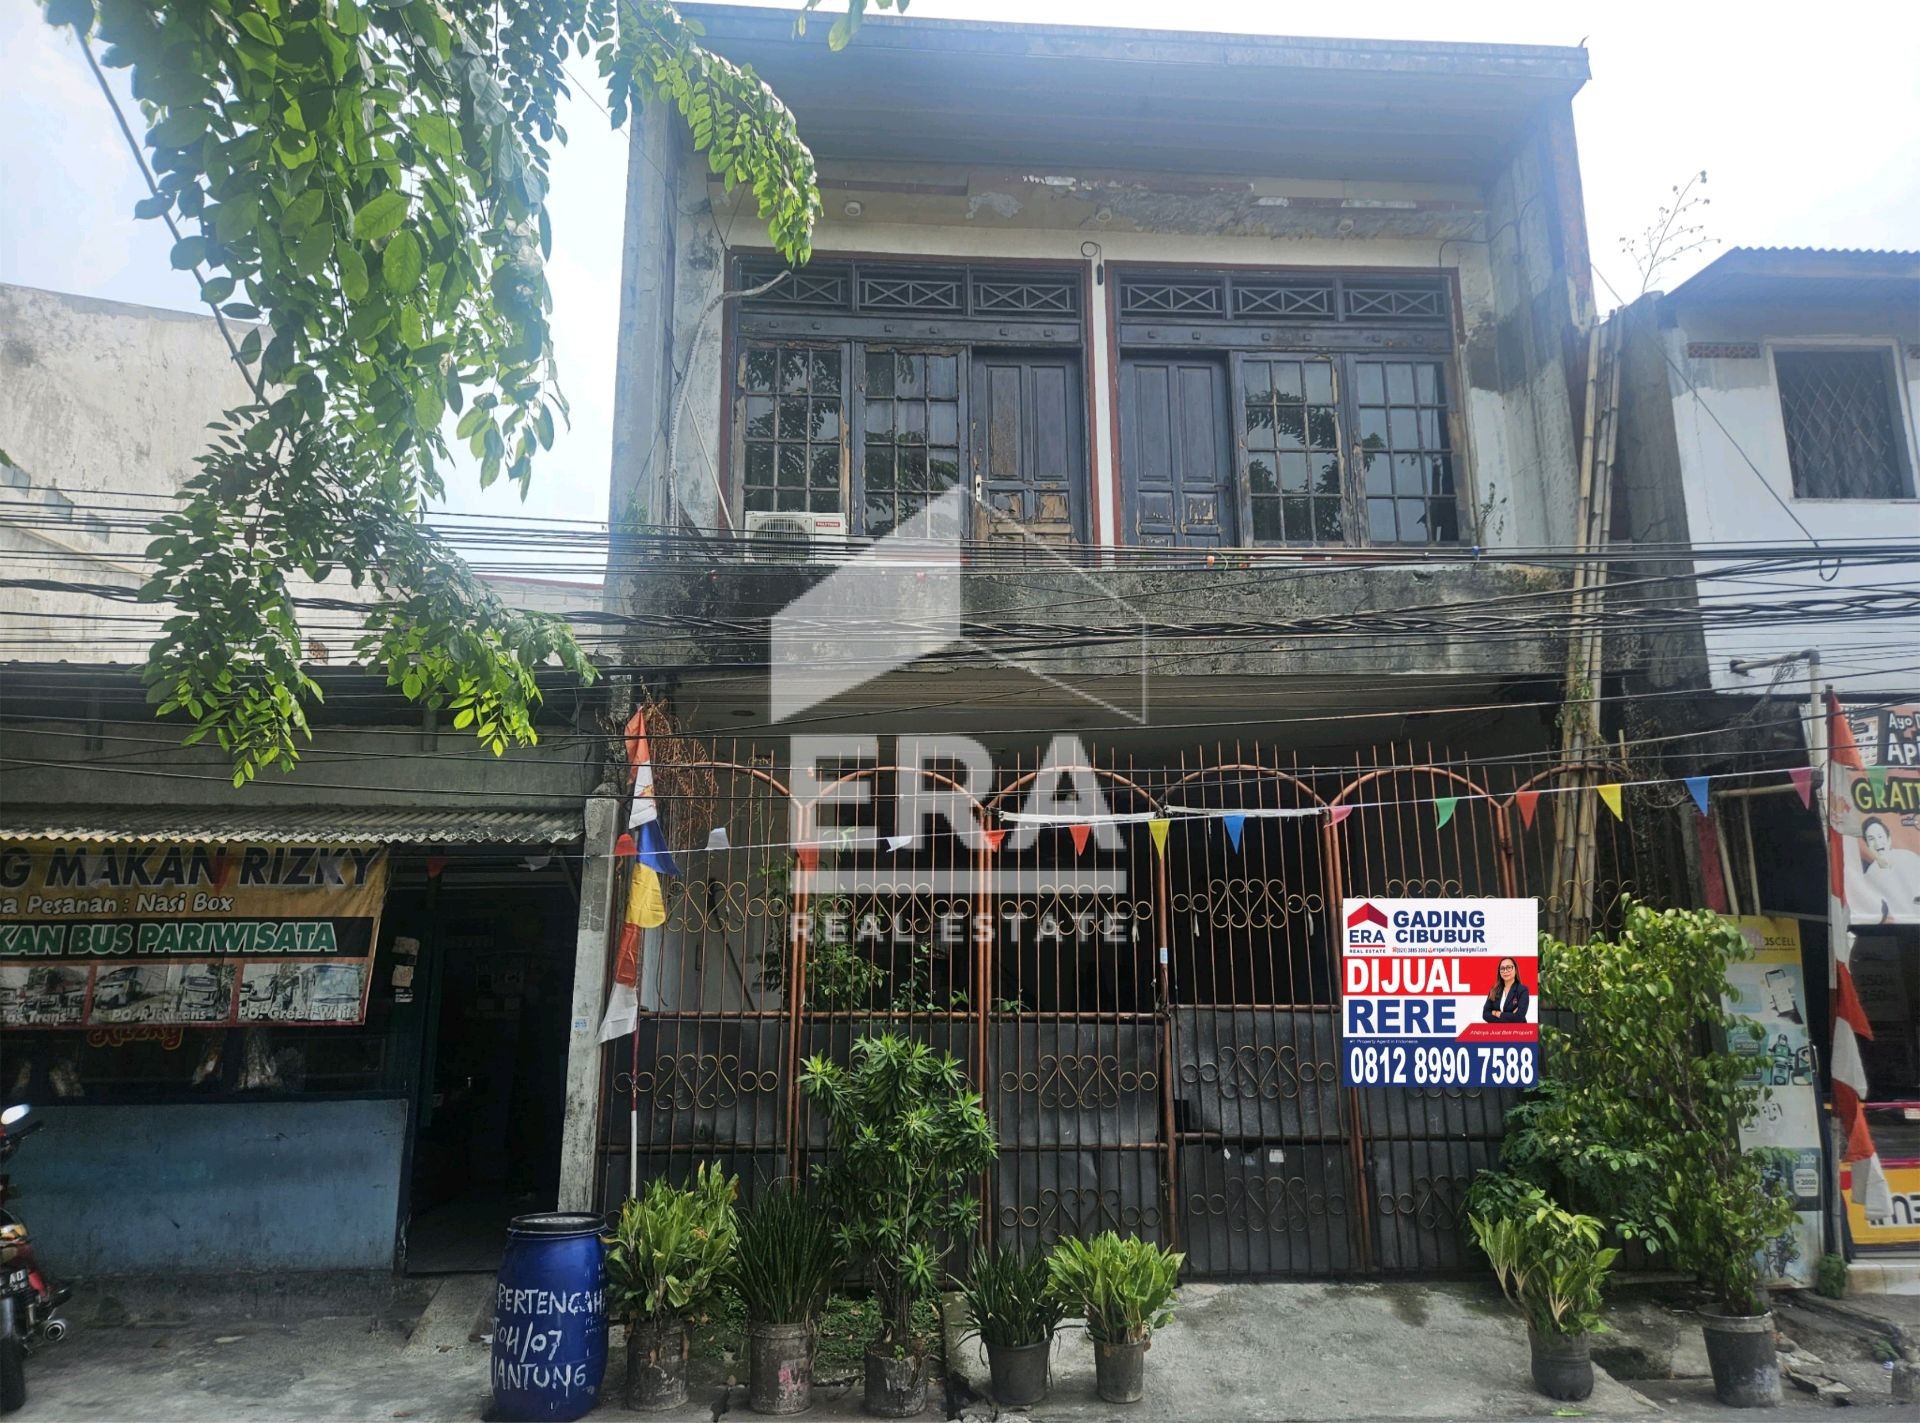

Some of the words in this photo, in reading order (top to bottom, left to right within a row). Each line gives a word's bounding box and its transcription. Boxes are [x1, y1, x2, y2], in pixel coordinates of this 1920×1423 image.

[1889, 712, 1913, 729] Ayo
[44, 847, 229, 888] MAKAN
[239, 847, 379, 887] RIZKY
[27, 895, 118, 914] Pesanan
[136, 893, 187, 913] Nasi
[192, 893, 234, 912] Box
[1393, 910, 1485, 928] GADING
[68, 923, 134, 955] BUS
[137, 921, 338, 954] PARIWISATA
[1349, 930, 1386, 943] ERA
[1395, 929, 1485, 944] CIBUBUR
[1347, 958, 1471, 993] DIJUAL
[1348, 999, 1457, 1034] RERE
[1350, 1047, 1407, 1084] 0812
[1414, 1047, 1470, 1084] 8990
[1477, 1047, 1534, 1084] 7588
